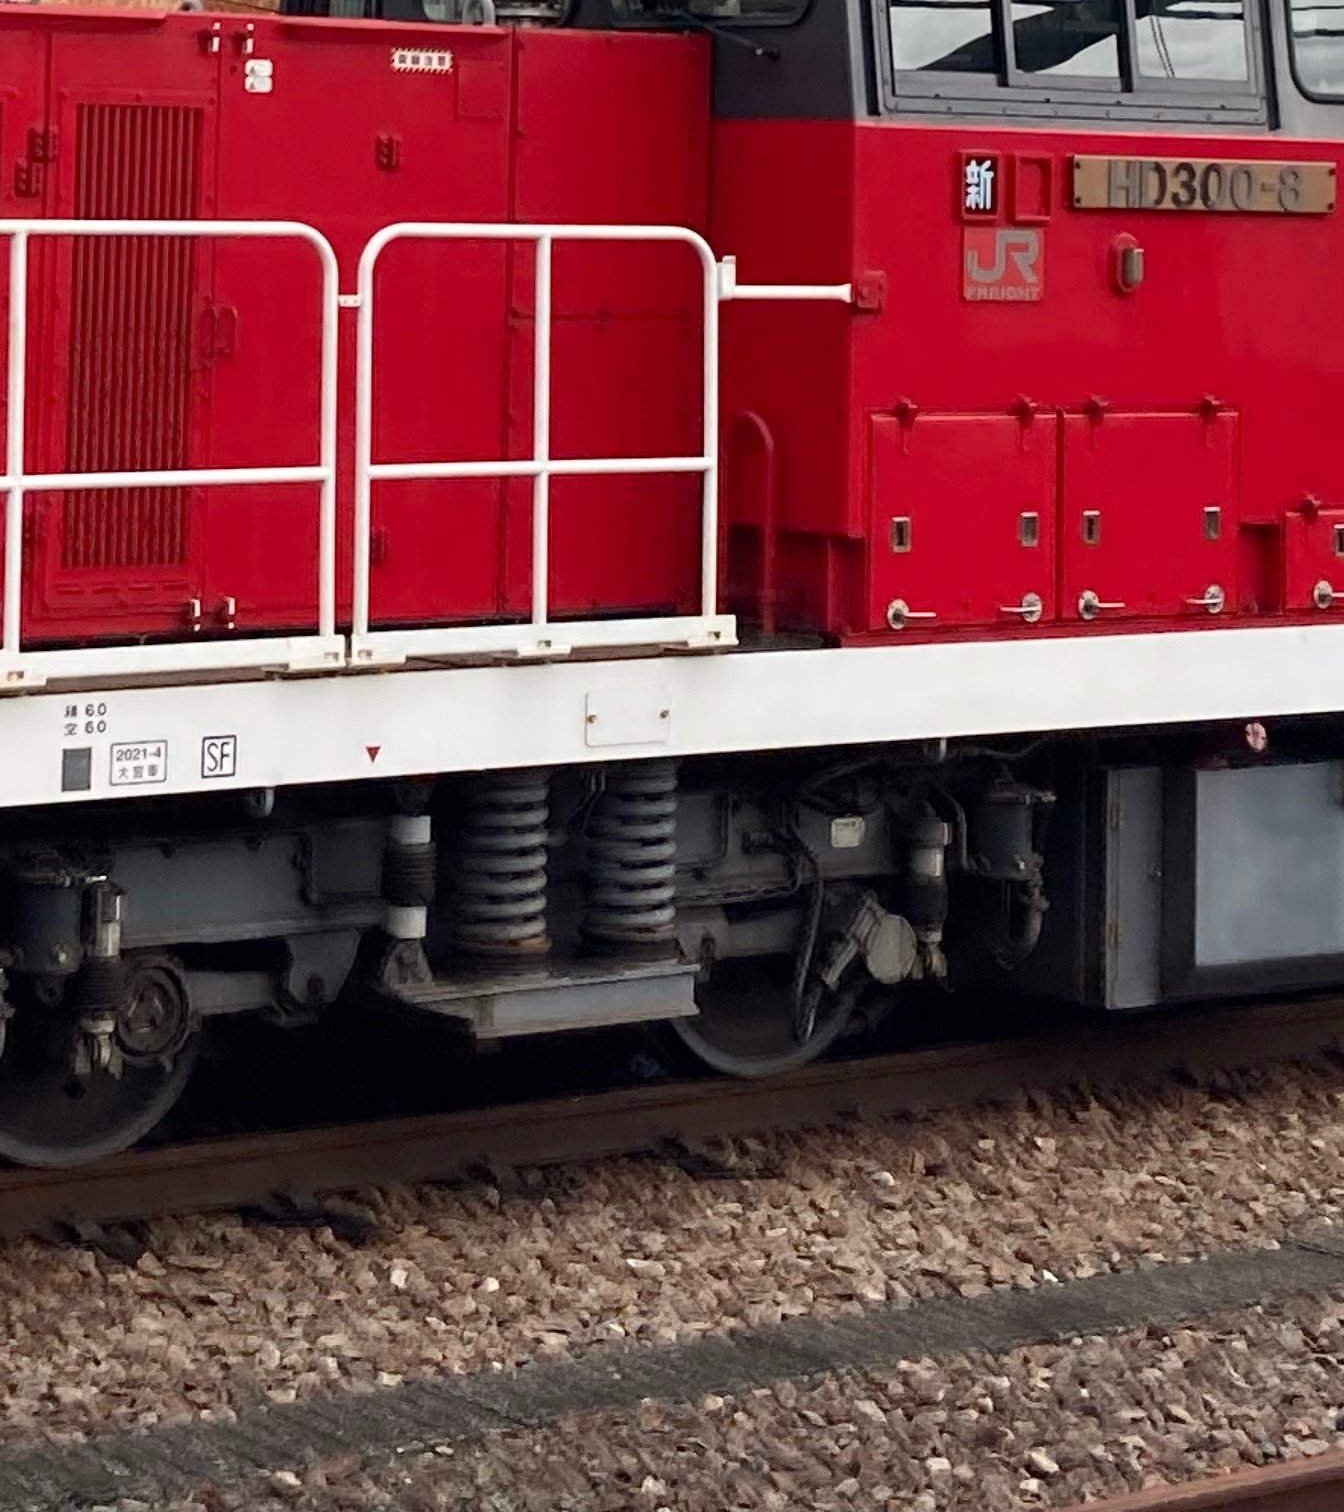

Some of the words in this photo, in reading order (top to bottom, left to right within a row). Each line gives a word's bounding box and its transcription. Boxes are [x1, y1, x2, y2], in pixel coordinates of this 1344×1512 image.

[964, 159, 995, 210] 新
[1106, 159, 1305, 212] HD300-8
[966, 230, 1039, 283] JR
[85, 702, 107, 717] 60
[85, 720, 107, 734] 60
[116, 746, 162, 762] 2021-4
[206, 741, 232, 773] SF
